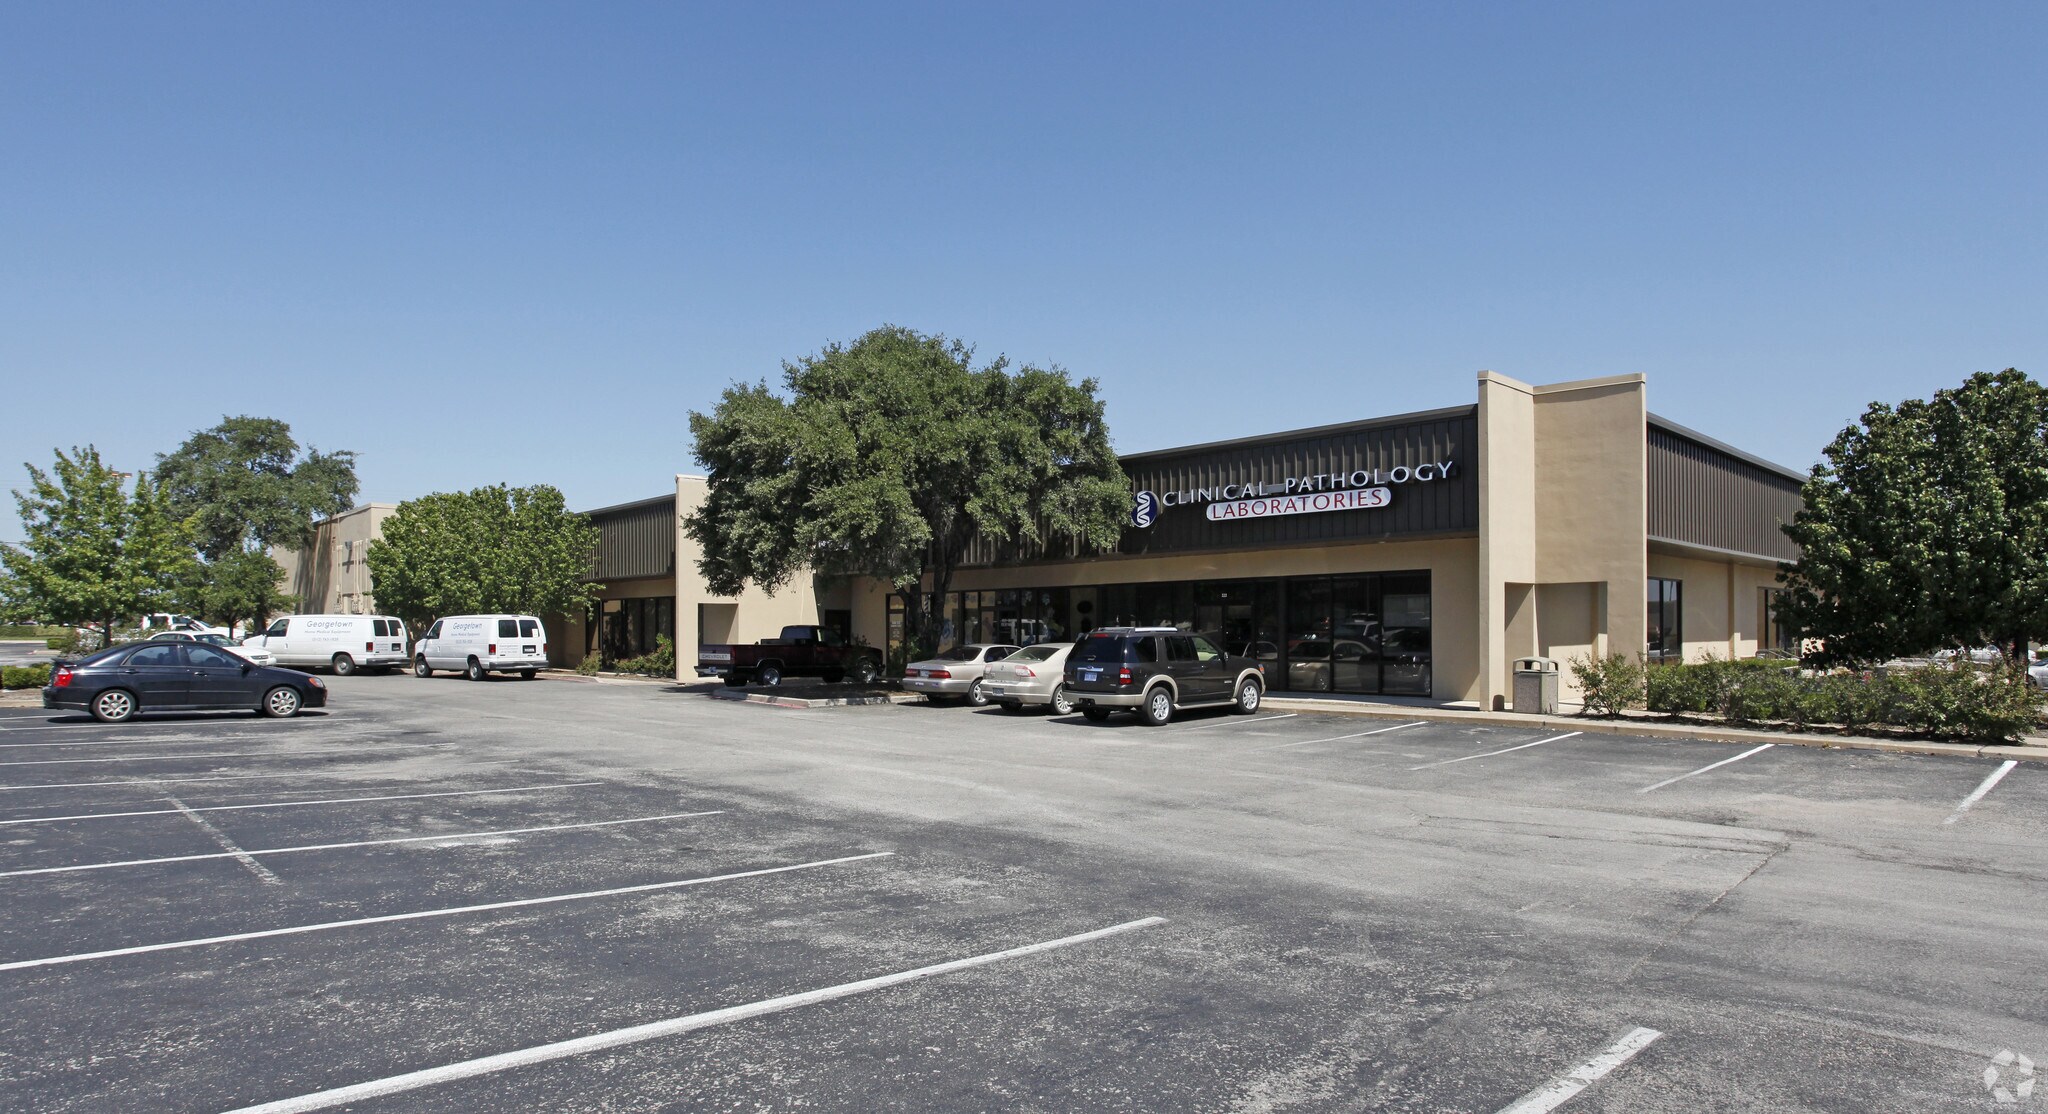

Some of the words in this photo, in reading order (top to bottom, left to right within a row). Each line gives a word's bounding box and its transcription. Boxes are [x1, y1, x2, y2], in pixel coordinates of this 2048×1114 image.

[1162, 480, 1271, 507] CLINICAL
[1285, 460, 1454, 494] PATHOLOGY
[1212, 488, 1383, 519] LABORATORIES
[306, 620, 353, 629] Georgetown
[452, 622, 482, 631] Georgetown
